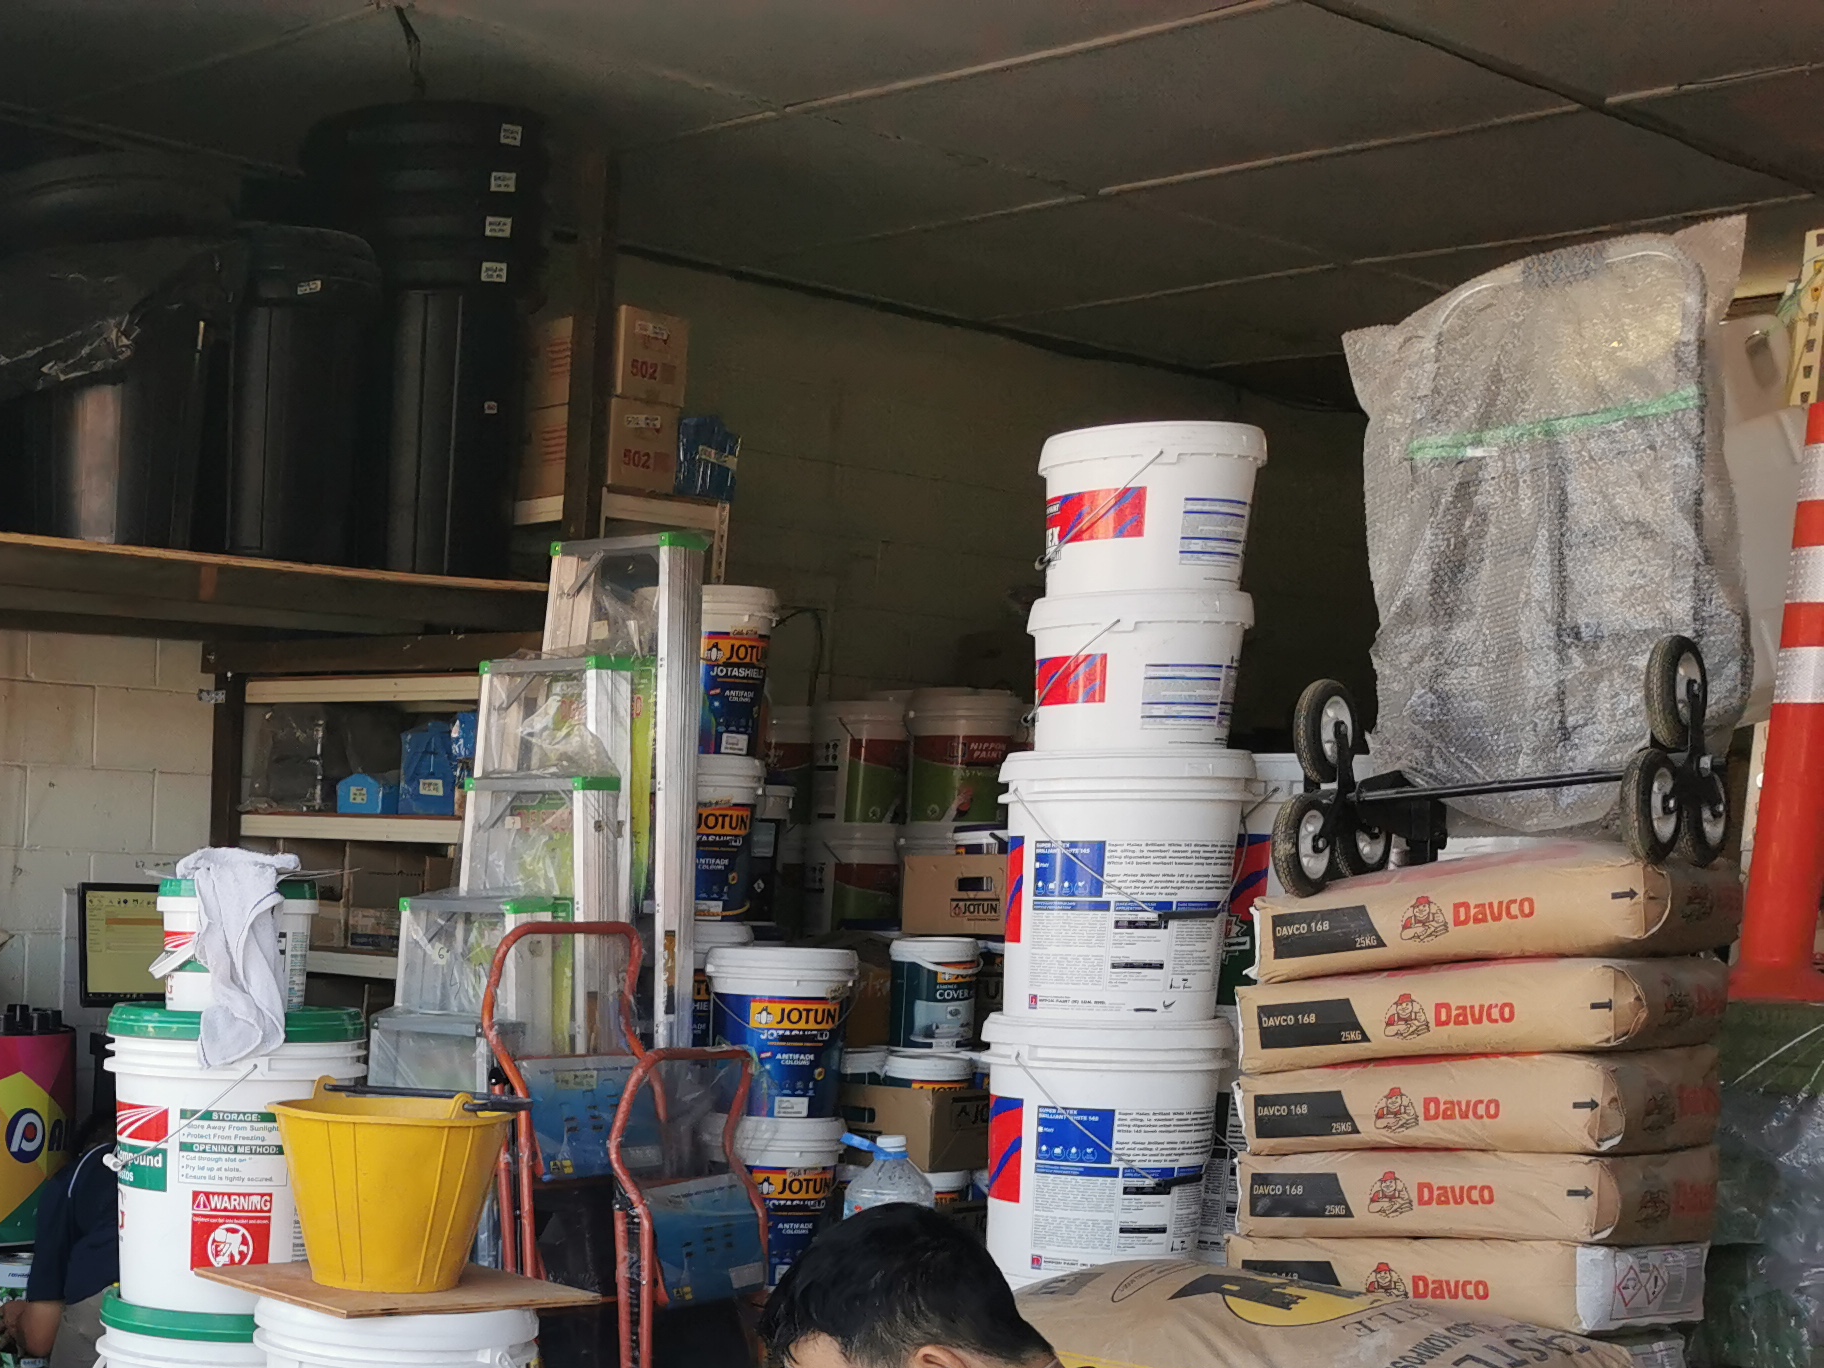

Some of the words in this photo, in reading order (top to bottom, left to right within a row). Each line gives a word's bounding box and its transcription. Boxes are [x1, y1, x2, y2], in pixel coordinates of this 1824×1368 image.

[630, 359, 658, 380] 502
[623, 449, 651, 470] 502
[710, 665, 764, 679] JOTASHIELD
[725, 690, 754, 698] ANTIFADE
[961, 902, 998, 915] JOTUN
[1452, 896, 1535, 927] Davco
[1276, 922, 1305, 937] DAVCO
[1307, 920, 1330, 933] 168
[1355, 936, 1378, 948] 25KG
[936, 989, 969, 1000] COVER
[776, 1007, 838, 1026] JOTUN
[1262, 1015, 1293, 1028] DAVCO
[1295, 1013, 1316, 1025] 168
[1434, 1001, 1516, 1028] Davco
[1340, 1030, 1362, 1042] 25KG
[775, 1052, 815, 1061] ANTIFADE
[1257, 1105, 1287, 1117] DAVCO
[1289, 1103, 1308, 1115] 168
[1422, 1096, 1501, 1121] Davco
[211, 1112, 261, 1122] STORAGE:
[206, 1124, 226, 1132] Away
[1331, 1122, 1352, 1133] 25KG
[187, 1132, 211, 1140] Protect
[234, 1133, 266, 1142] Freezing.
[193, 1143, 235, 1153] OPENING
[236, 1144, 279, 1154] METHOD:
[117, 1144, 163, 1168] ompound
[197, 1155, 223, 1163] through
[185, 1164, 196, 1172] Pry
[207, 1165, 215, 1173] up
[208, 1173, 216, 1181] lid
[224, 1174, 245, 1183] tightly
[1252, 1185, 1281, 1196] DAVCO
[1284, 1184, 1304, 1195] 168
[1417, 1181, 1495, 1207] Davco
[209, 1194, 271, 1211] WARNING
[1325, 1205, 1346, 1216] 25KG
[778, 1222, 813, 1230] ANTIFADE
[1412, 1274, 1490, 1301] Davco
